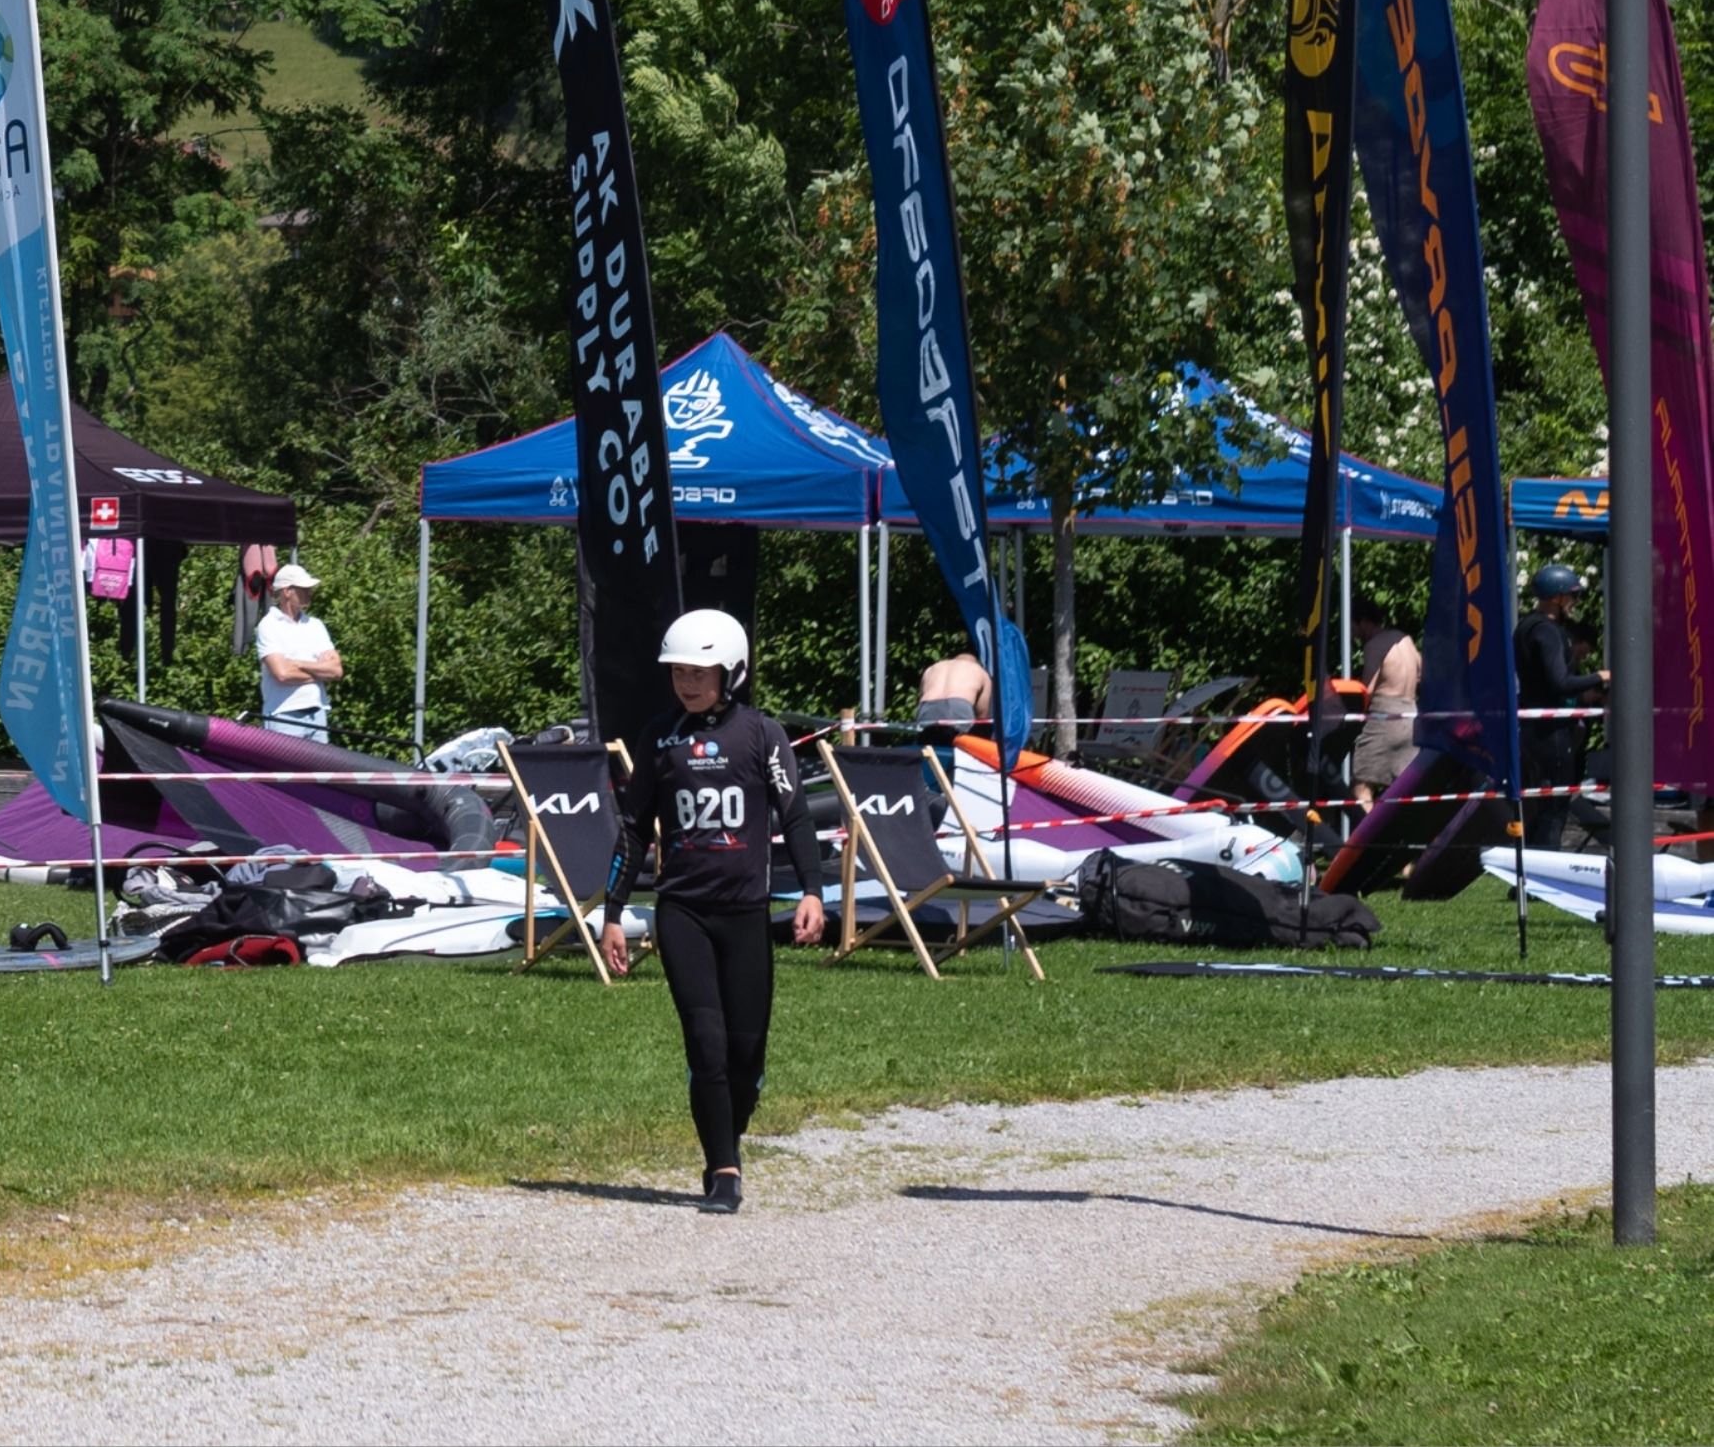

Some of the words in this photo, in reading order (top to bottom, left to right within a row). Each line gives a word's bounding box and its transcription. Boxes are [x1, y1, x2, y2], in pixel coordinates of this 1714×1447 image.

[591, 130, 619, 227] AK
[572, 151, 613, 394] SUPPLY
[598, 428, 630, 555] CO.
[604, 239, 661, 565] DURABLE
[675, 785, 745, 830] 820
